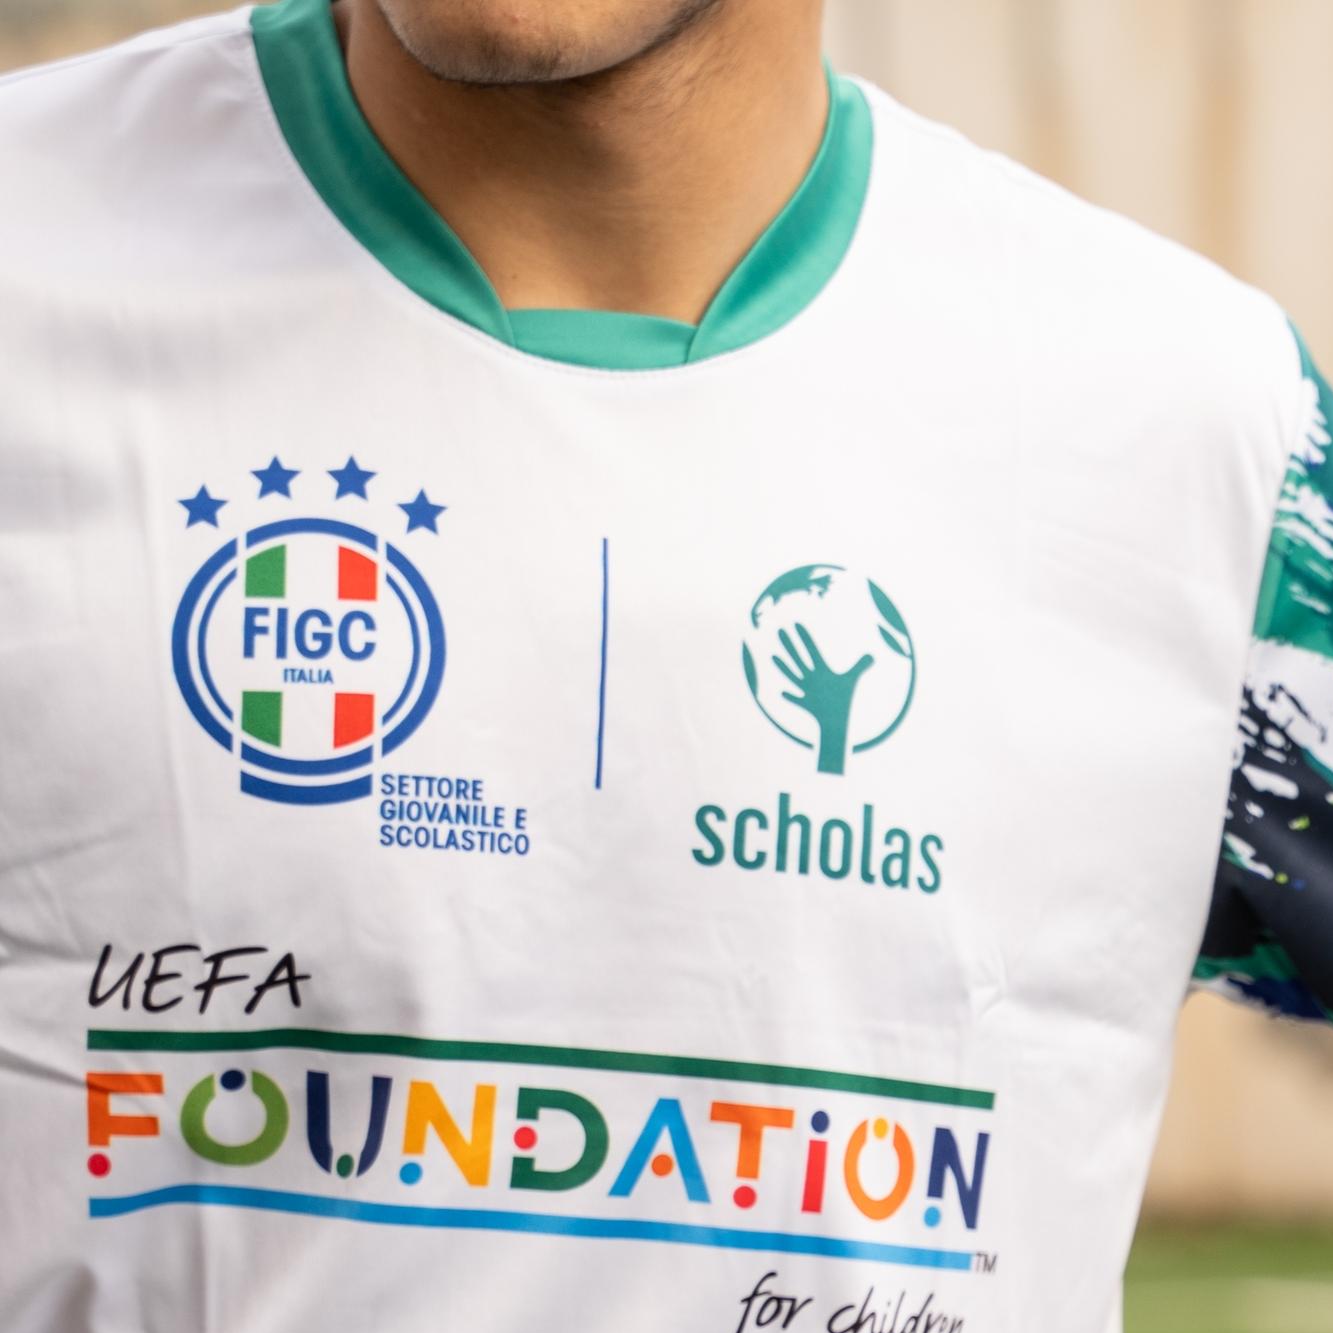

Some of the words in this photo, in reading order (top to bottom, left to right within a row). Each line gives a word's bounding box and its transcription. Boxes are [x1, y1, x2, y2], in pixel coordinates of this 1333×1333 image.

[242, 606, 377, 662] FIGC
[283, 668, 334, 684] ITALIA
[380, 774, 483, 801] SETTORE
[380, 799, 505, 828] GIOVANILE
[515, 808, 527, 829] E
[380, 825, 530, 855] SCOLASTICO
[691, 792, 944, 895] scholas
[87, 943, 311, 1015] UEFA
